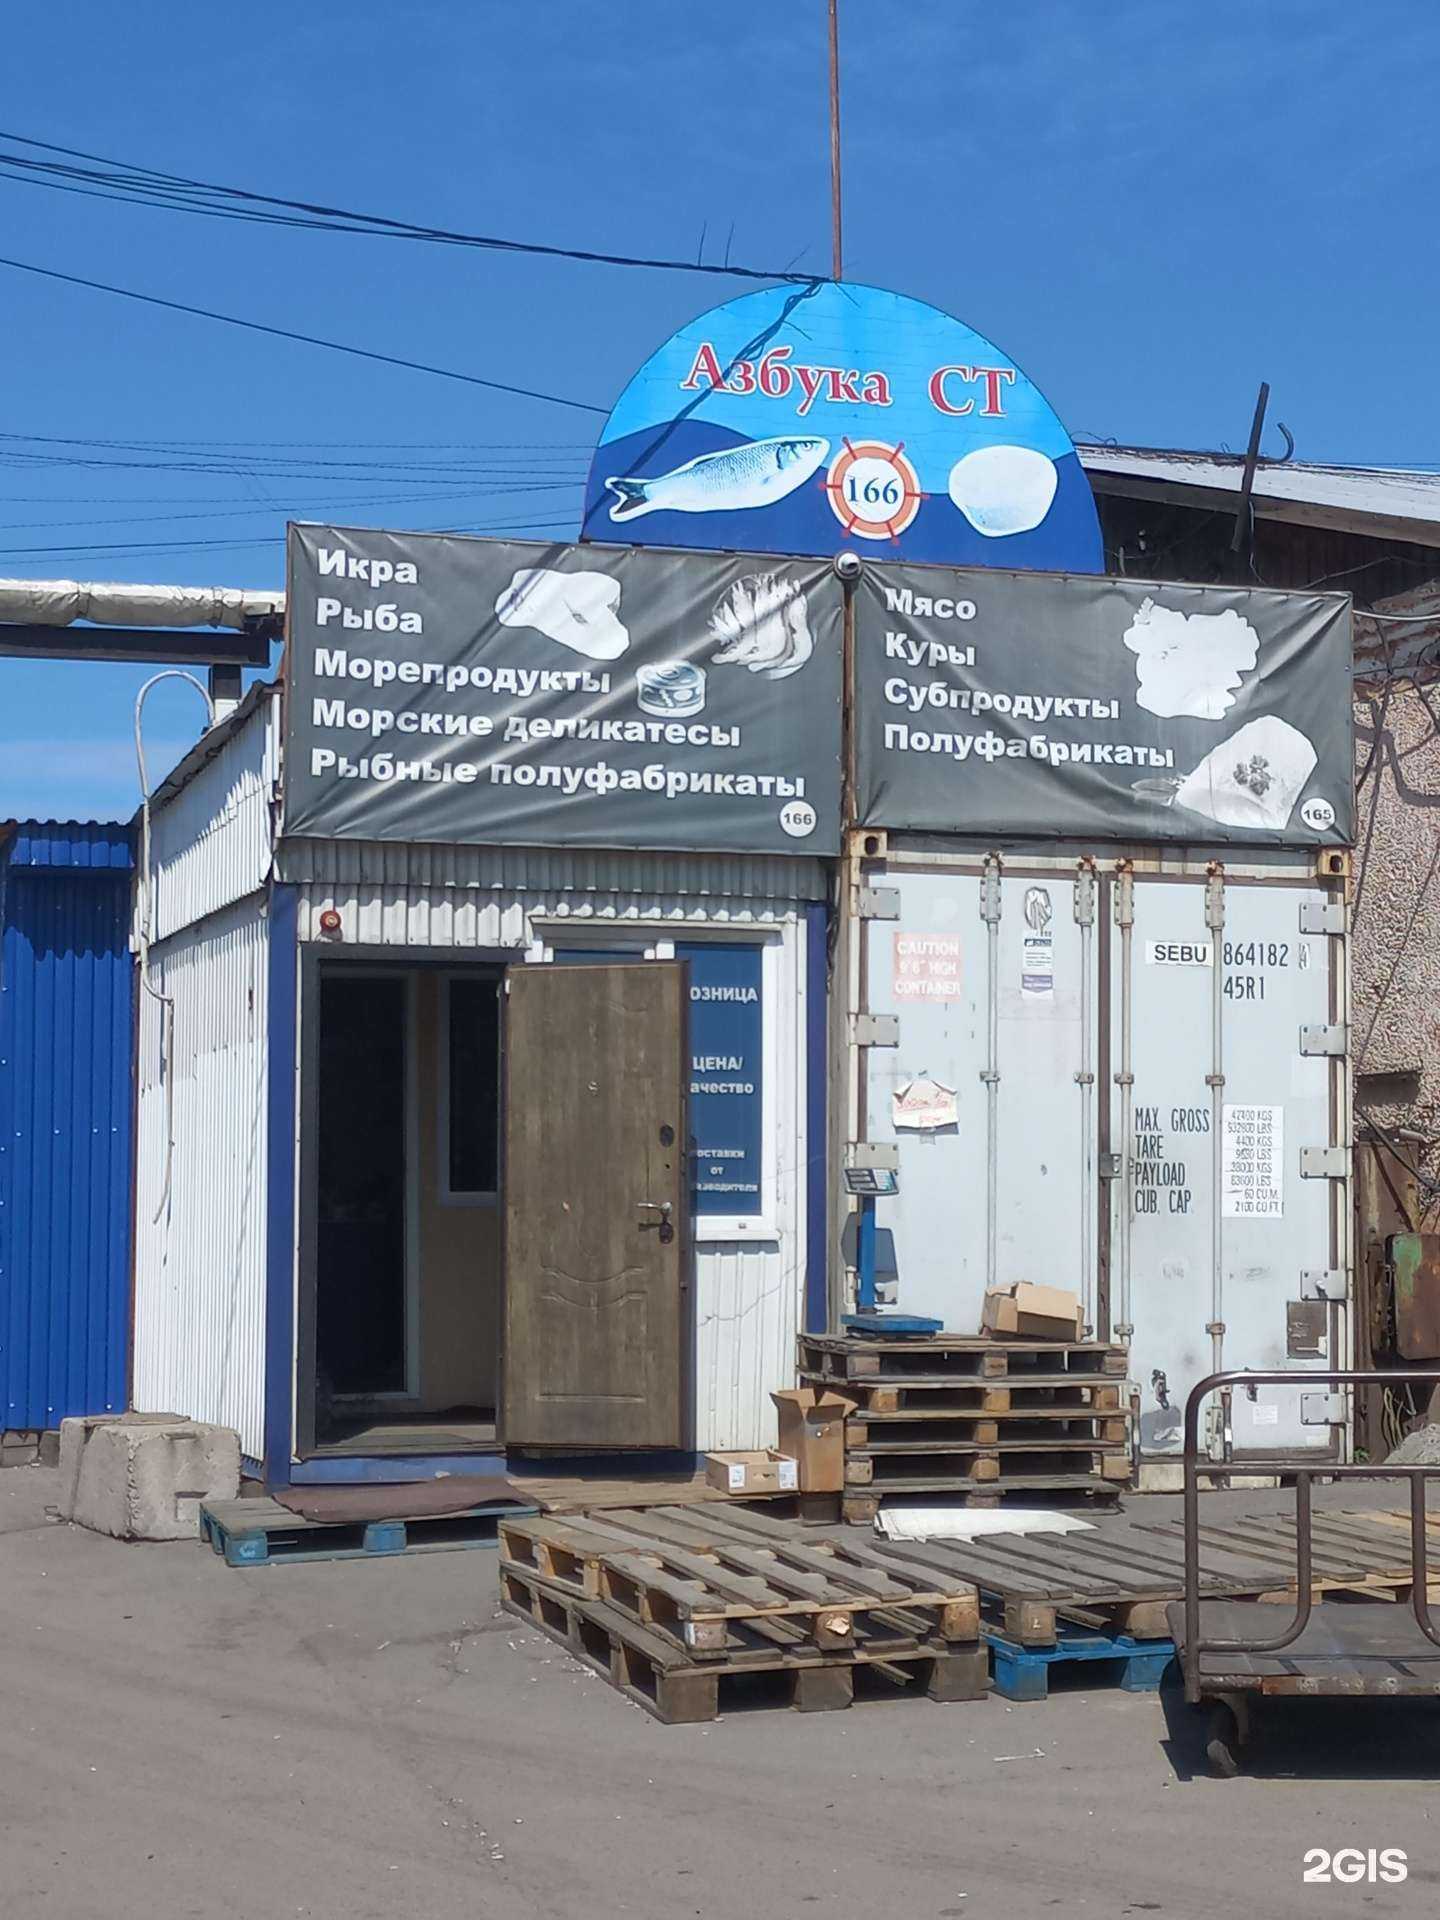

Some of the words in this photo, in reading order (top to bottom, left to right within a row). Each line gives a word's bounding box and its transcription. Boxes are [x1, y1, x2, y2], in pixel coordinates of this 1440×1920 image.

[681, 342, 892, 416] Азбука
[927, 364, 1016, 418] СТ
[845, 475, 899, 507] 166
[317, 548, 418, 588] Икра
[316, 598, 424, 636] Рыба
[884, 587, 977, 622] Мясо
[884, 632, 976, 668] Куры
[314, 647, 612, 698] Морепродукты
[883, 678, 1120, 723] Субпродукты
[312, 698, 494, 738] Морские
[503, 716, 741, 749] деликатесы
[883, 724, 1174, 769] Полуфабрикаты
[311, 748, 478, 785] Рыбные
[490, 761, 806, 799] полуфабрикаты
[783, 811, 813, 827] 166
[1303, 807, 1332, 823] 165
[897, 941, 960, 956] CAUTION
[1154, 944, 1207, 964] SEBU
[1223, 942, 1289, 967] 864182
[689, 986, 759, 1004] ОЗНИЦА
[1223, 976, 1266, 1001] 45R1
[690, 1082, 755, 1094] ачество
[1135, 1107, 1162, 1132] MAX.
[1171, 1108, 1210, 1133] GROSS
[697, 1149, 745, 1158] оставки
[1135, 1134, 1165, 1159] TARE
[1134, 1162, 1186, 1187] PAYLOAD
[1134, 1189, 1161, 1214] CUB.
